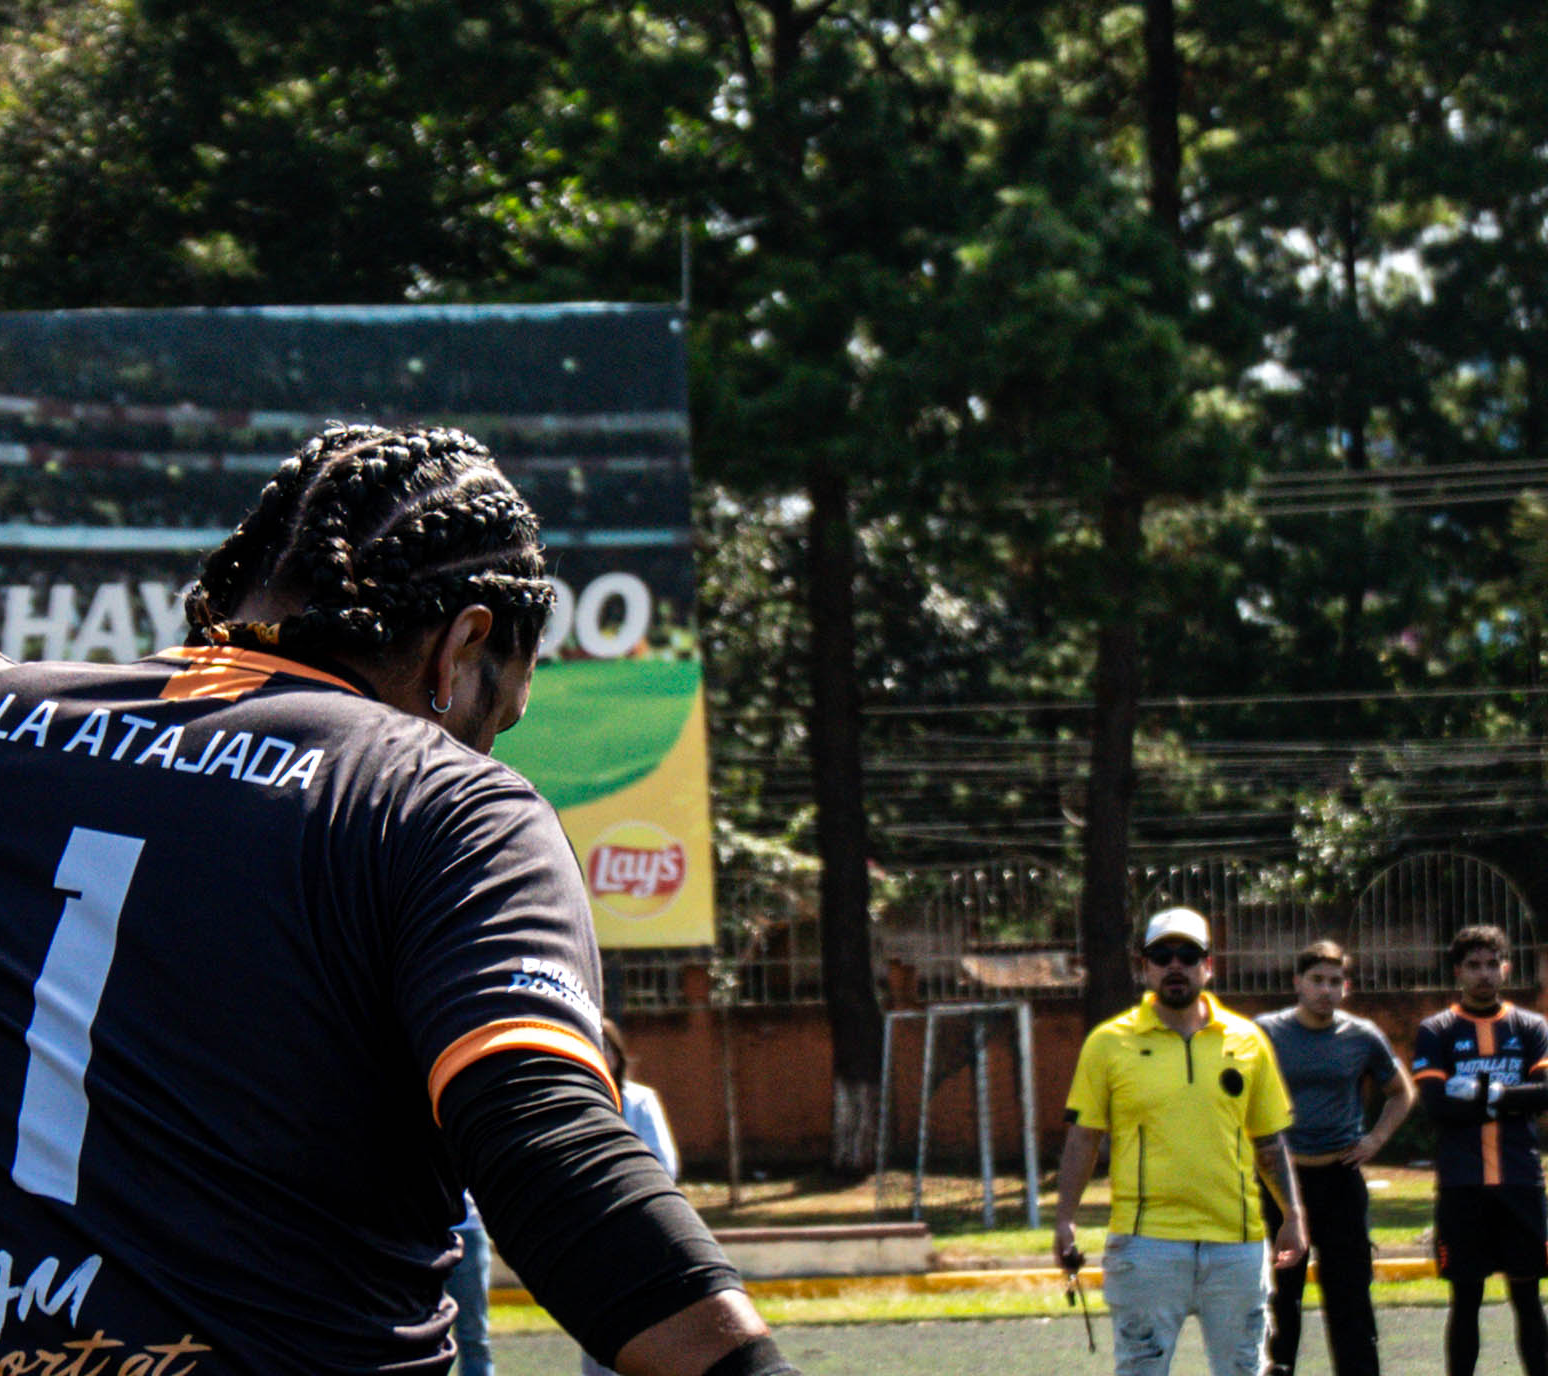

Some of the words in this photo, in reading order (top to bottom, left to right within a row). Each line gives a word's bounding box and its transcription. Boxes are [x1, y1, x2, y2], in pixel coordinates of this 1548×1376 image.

[3, 580, 197, 666] HAY
[63, 708, 325, 790] ATAJADA
[11, 826, 146, 1206] 1
